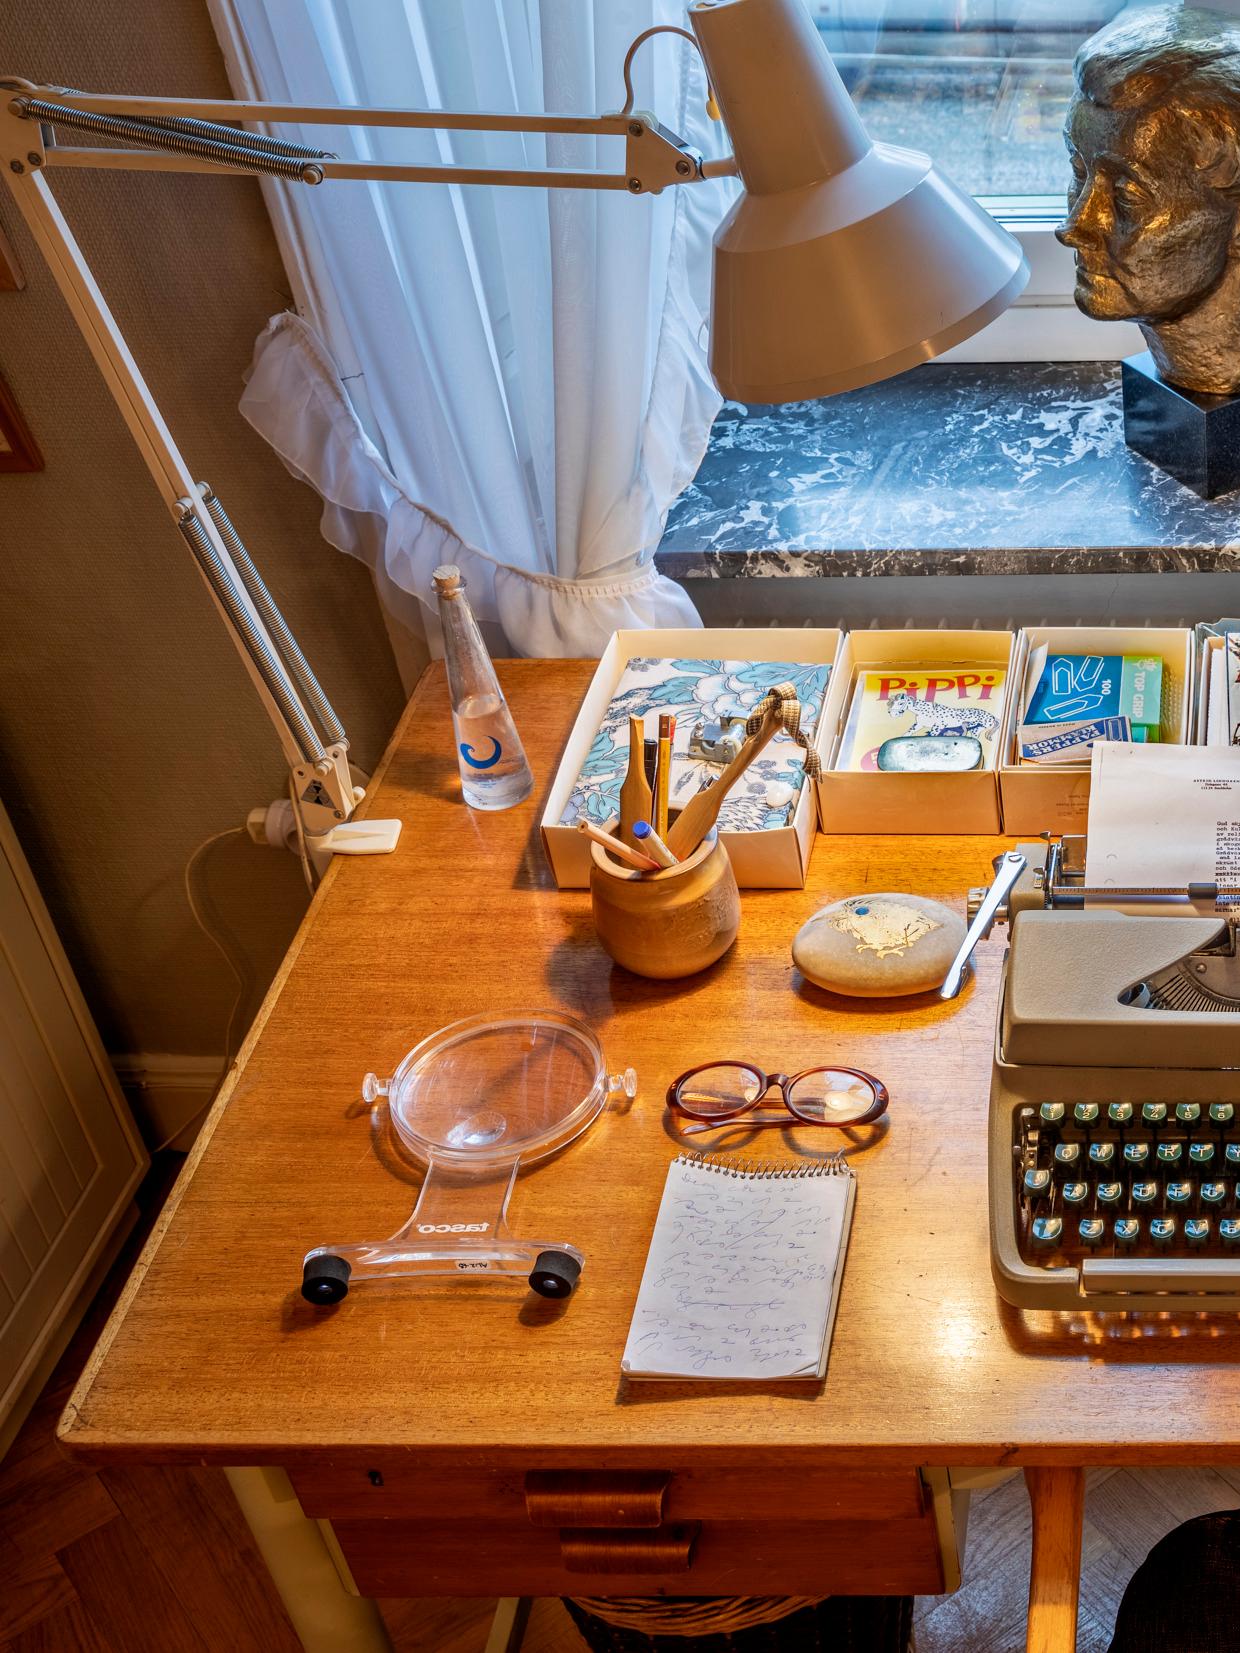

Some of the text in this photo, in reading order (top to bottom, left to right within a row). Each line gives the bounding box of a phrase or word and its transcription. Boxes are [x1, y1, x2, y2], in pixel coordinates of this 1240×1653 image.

[1101, 679, 1112, 696] 100
[1131, 671, 1146, 718] TOP GRIP
[1032, 731, 1100, 756] PAPPERS
